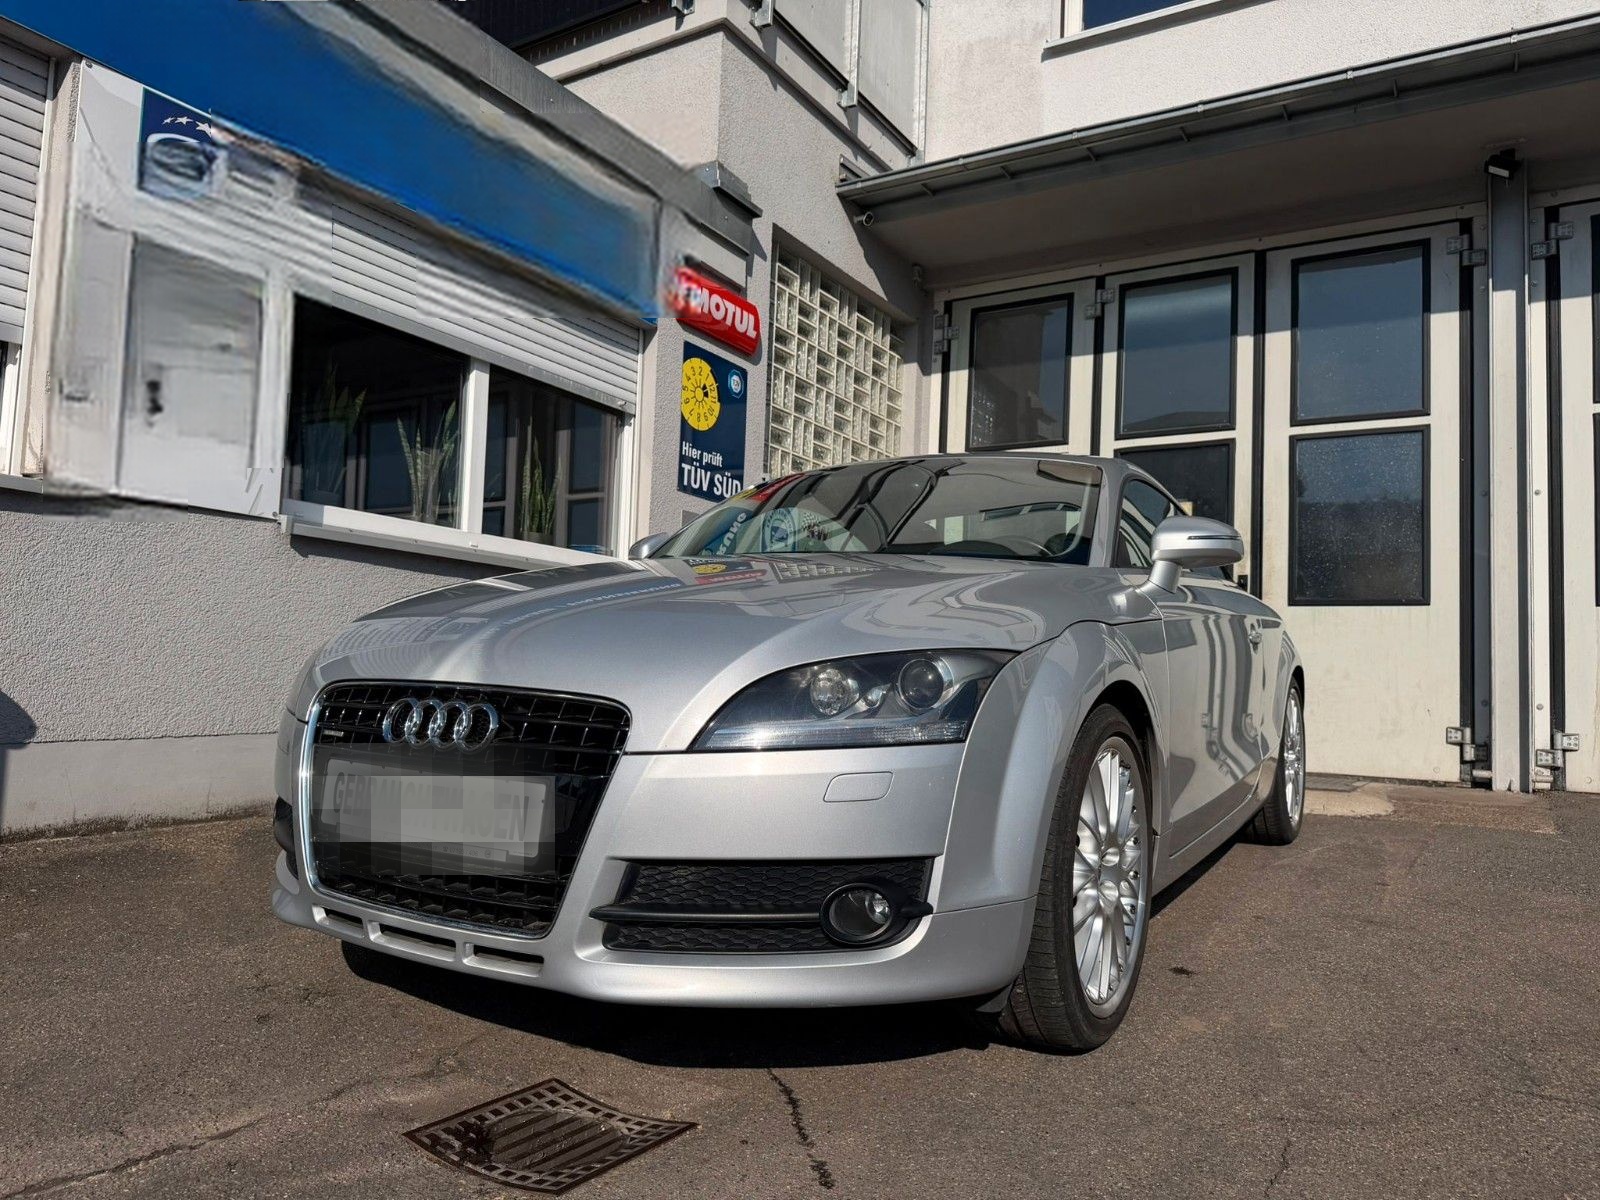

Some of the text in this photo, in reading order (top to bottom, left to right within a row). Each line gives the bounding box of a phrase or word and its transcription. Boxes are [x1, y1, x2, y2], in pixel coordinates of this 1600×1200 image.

[690, 286, 757, 339] MOTUL
[691, 366, 696, 376] 3
[698, 366, 703, 376] 2
[682, 441, 724, 468] Hier prüft
[681, 461, 741, 499] TÜV SÜD
[333, 771, 530, 842] GEBRAUCHTWAGEN
